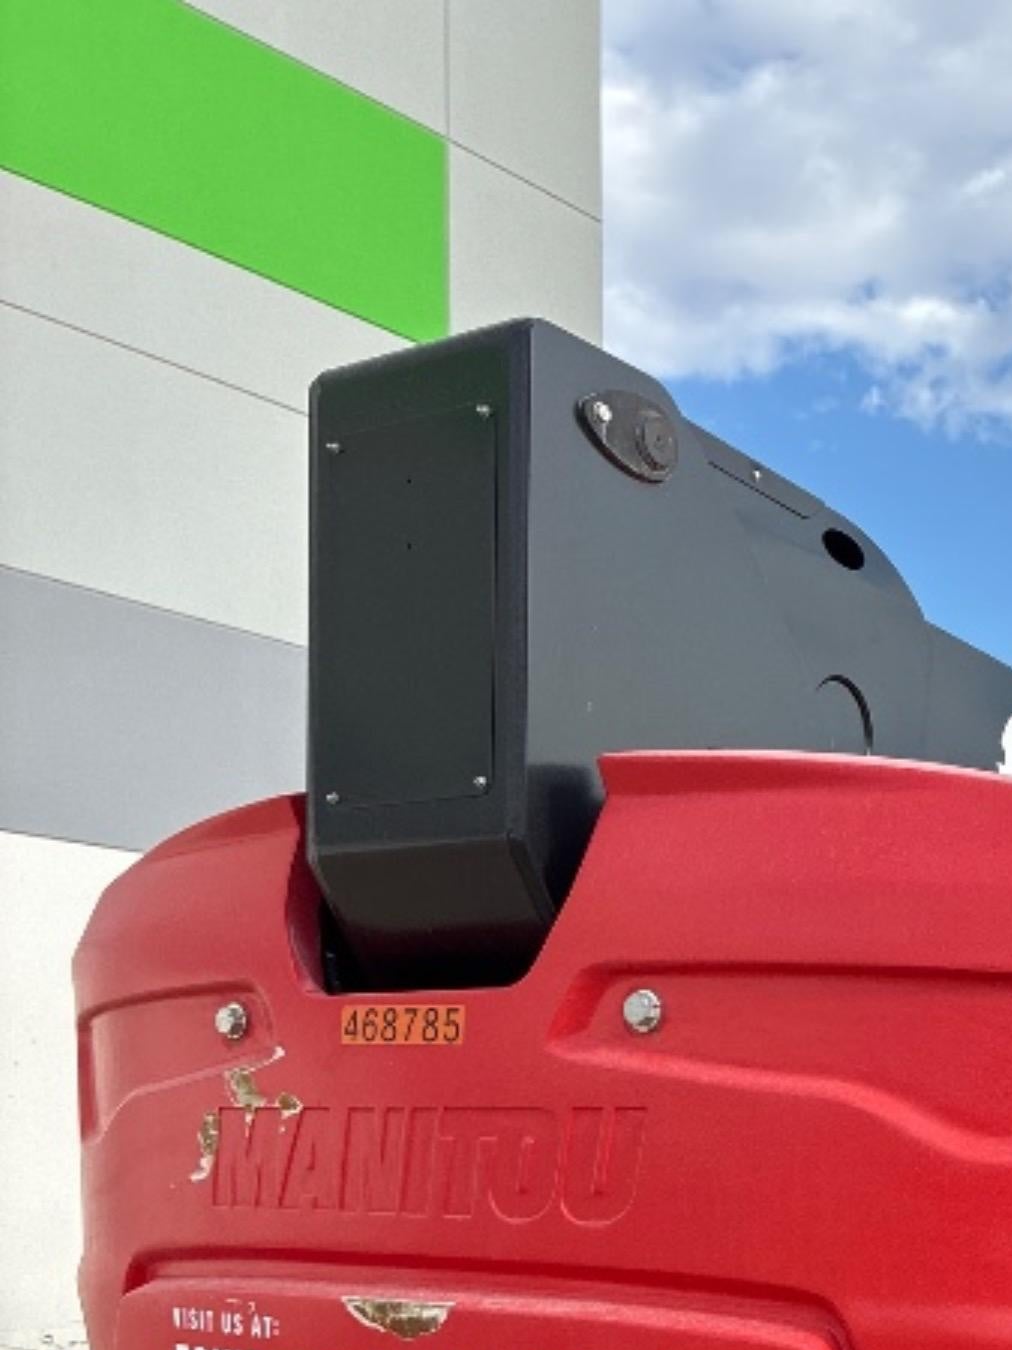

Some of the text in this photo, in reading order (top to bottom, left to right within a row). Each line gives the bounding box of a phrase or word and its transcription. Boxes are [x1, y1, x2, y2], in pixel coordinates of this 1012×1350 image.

[344, 1007, 461, 1043] 468785
[210, 1105, 649, 1227] MANITOU
[173, 1307, 280, 1339] VISIT US AT:
